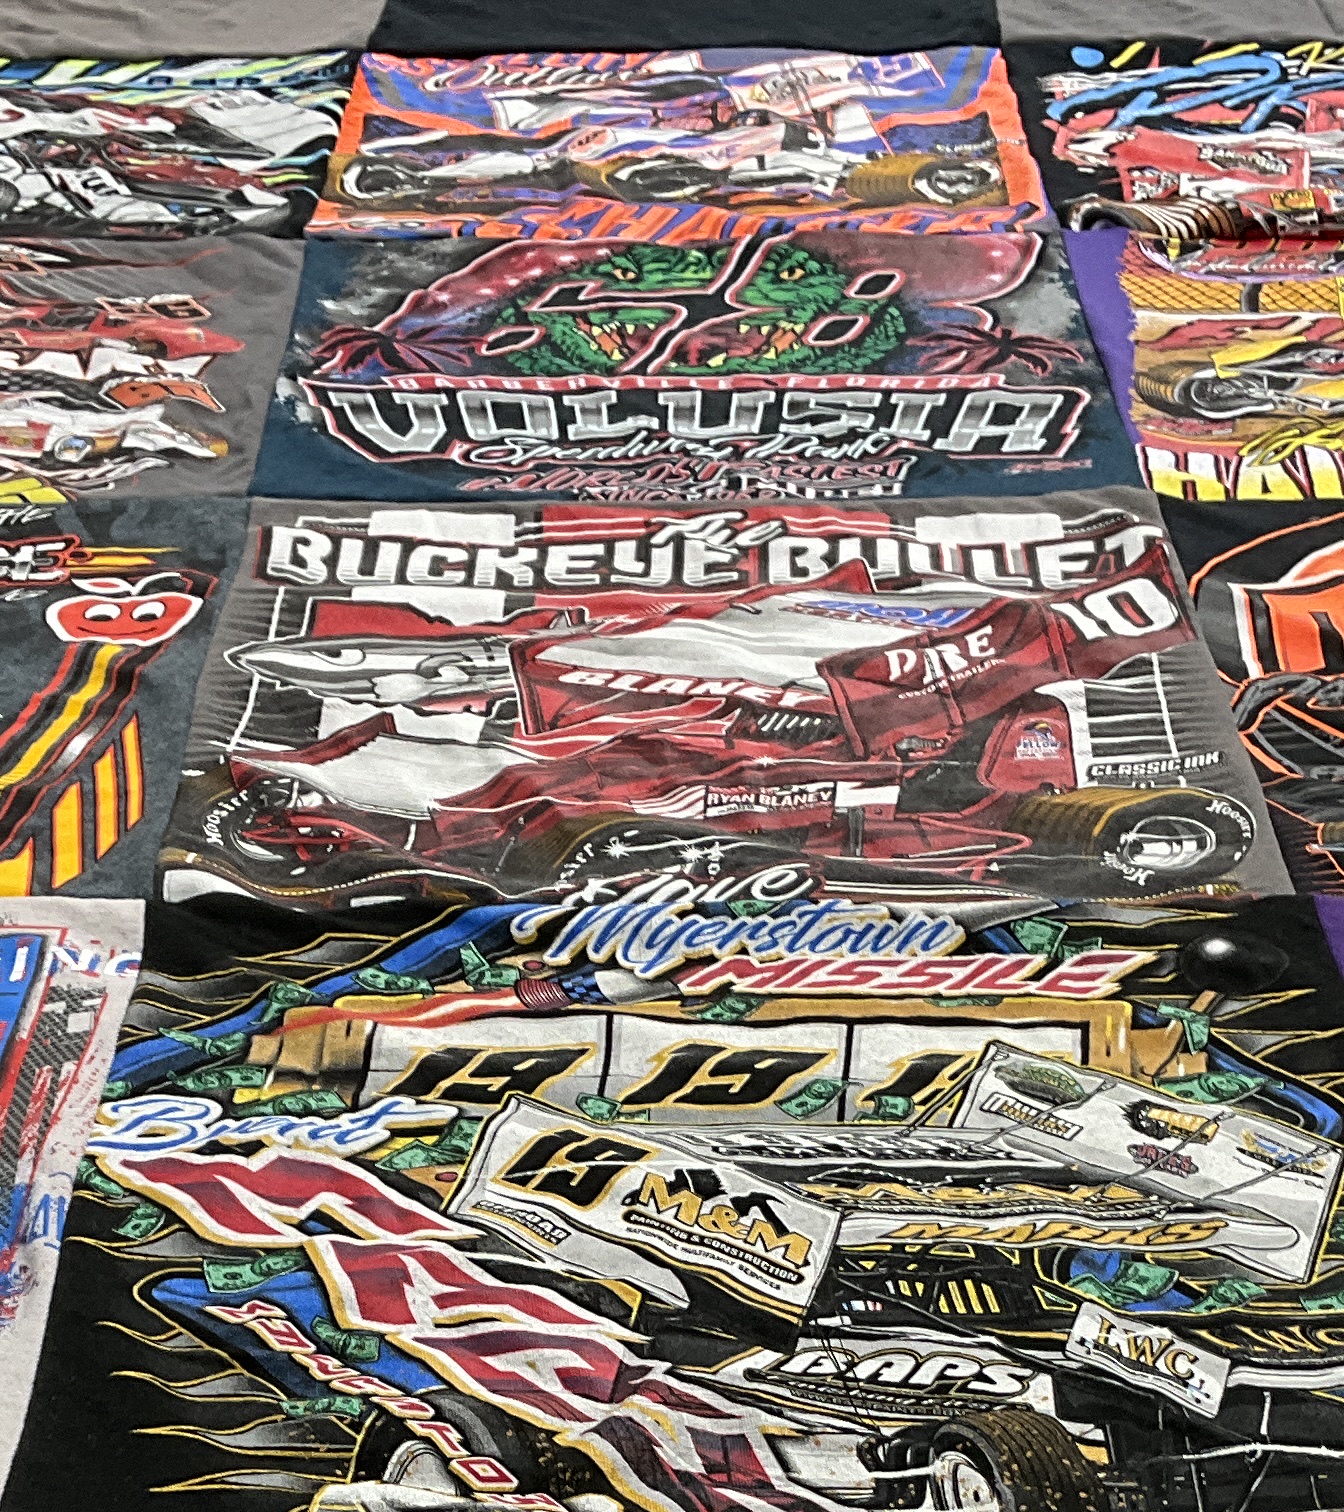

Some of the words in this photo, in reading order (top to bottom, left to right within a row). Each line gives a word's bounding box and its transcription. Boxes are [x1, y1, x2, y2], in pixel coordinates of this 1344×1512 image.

[328, 390, 1064, 453] VOLUSIA
[261, 524, 741, 589] BUCKEYE
[768, 526, 1168, 590] BULLET
[651, 509, 786, 554] The
[1051, 579, 1180, 641] 10
[557, 669, 829, 709] BLANEY
[1090, 757, 1173, 778] CLASSIC
[1174, 751, 1223, 770] INK
[706, 792, 757, 807] RYAN
[758, 790, 834, 807] BLANEY
[513, 897, 967, 974] Myerstown
[677, 952, 1157, 995] MISSILE
[615, 1043, 838, 1110] 19
[629, 1213, 689, 1241] PAINTING
[702, 1237, 800, 1283] CONSTRUCTION
[636, 1171, 813, 1267] M&M
[884, 1219, 1229, 1246] MARKS
[778, 1351, 1034, 1396] BAPS
[1089, 1314, 1199, 1380] LWC
